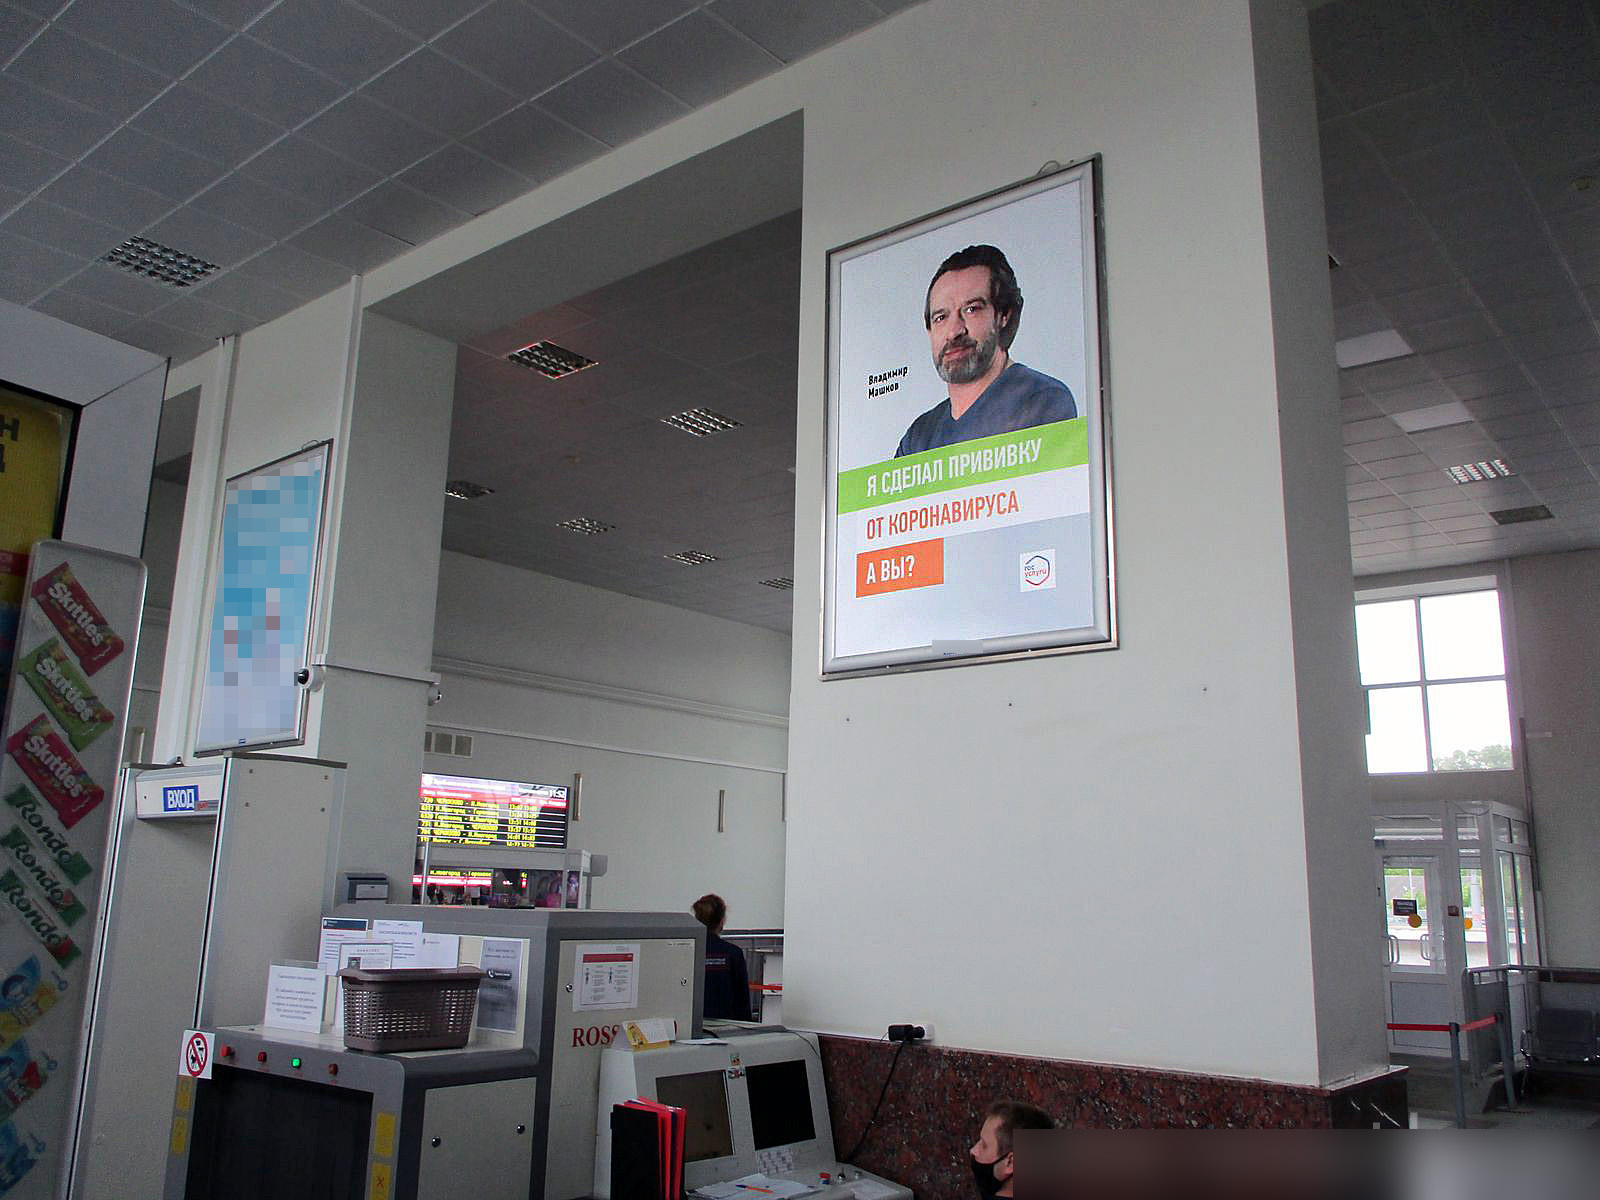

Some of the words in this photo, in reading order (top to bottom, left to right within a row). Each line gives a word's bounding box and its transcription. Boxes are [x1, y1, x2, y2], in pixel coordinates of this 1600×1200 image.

[868, 366, 908, 386] Владимир
[868, 382, 899, 399] Машков
[867, 474, 877, 497] Я
[881, 459, 943, 495] СДЕЛАЛ
[948, 437, 1042, 479] ПРИВИВКУ
[866, 515, 884, 541] ОТ
[888, 490, 1020, 537] КОРОНАВИРУСА
[866, 562, 876, 585] А
[880, 555, 915, 582] ВЫ?
[48, 581, 104, 648] Skittles
[36, 656, 95, 722] Skittles
[24, 735, 84, 799] Skittles
[167, 788, 195, 809] ВХОД
[16, 800, 73, 863] Rondo
[13, 840, 65, 903] Rondo
[9, 884, 62, 945] Rondo
